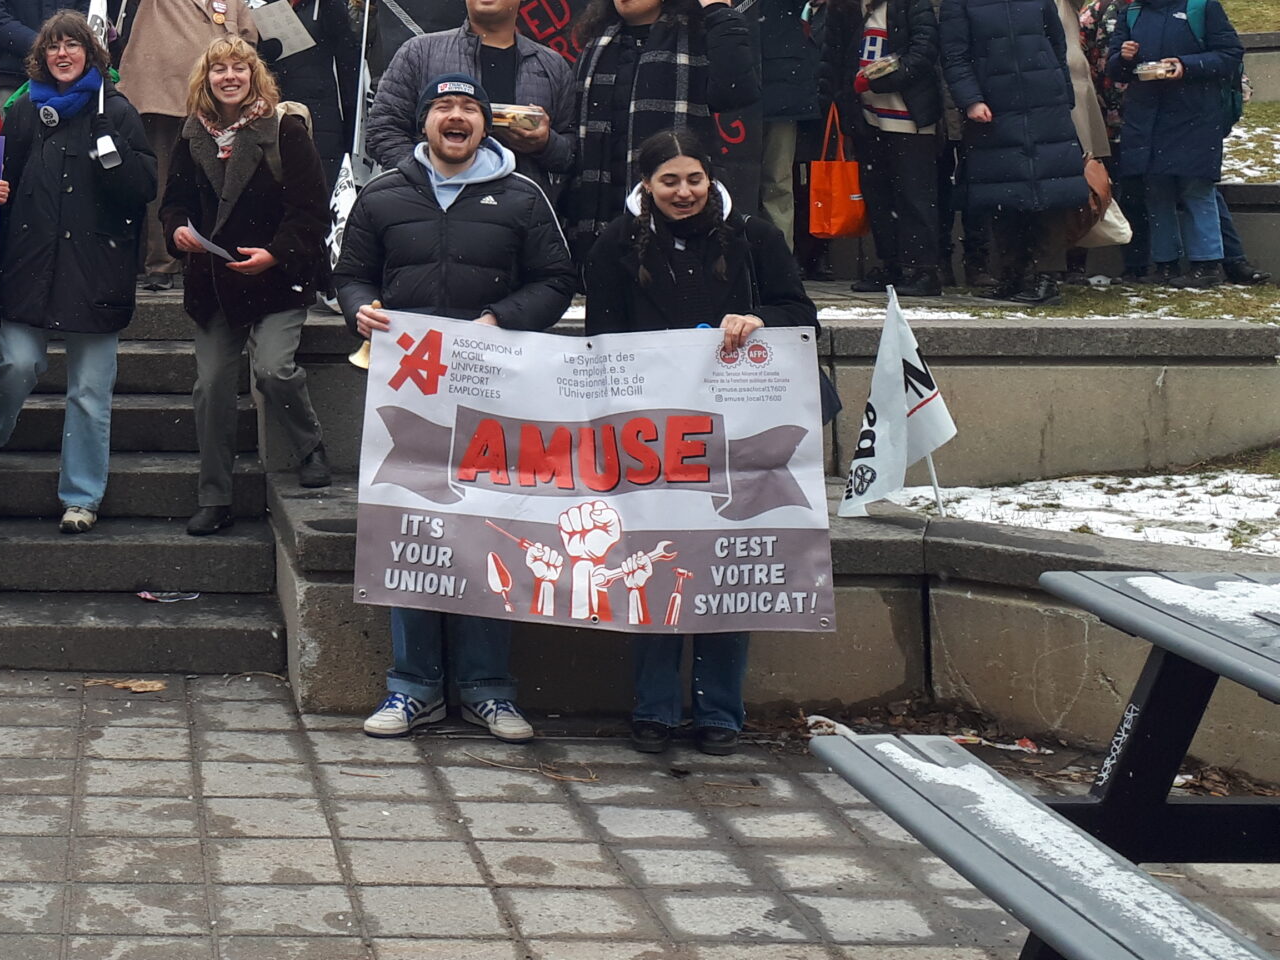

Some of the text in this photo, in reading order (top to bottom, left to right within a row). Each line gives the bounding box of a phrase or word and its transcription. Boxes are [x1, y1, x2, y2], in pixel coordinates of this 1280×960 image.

[451, 350, 485, 362] MCGILL
[452, 339, 513, 356] ASSOCIATION
[564, 352, 635, 366] Le Syndicat des
[451, 362, 503, 375] UNIVERSITY
[450, 374, 489, 386] SUPPORT
[632, 375, 645, 384] de
[448, 385, 501, 399] EMPLOYEES
[610, 385, 643, 397] McGill
[457, 415, 713, 491] AMUSE
[400, 513, 445, 539] IT'S
[389, 541, 453, 568] YOUR
[714, 535, 778, 558] C'EST
[711, 563, 786, 586] VOTRE
[384, 568, 467, 599] UNION!
[693, 591, 818, 616] SYNDICAT!
